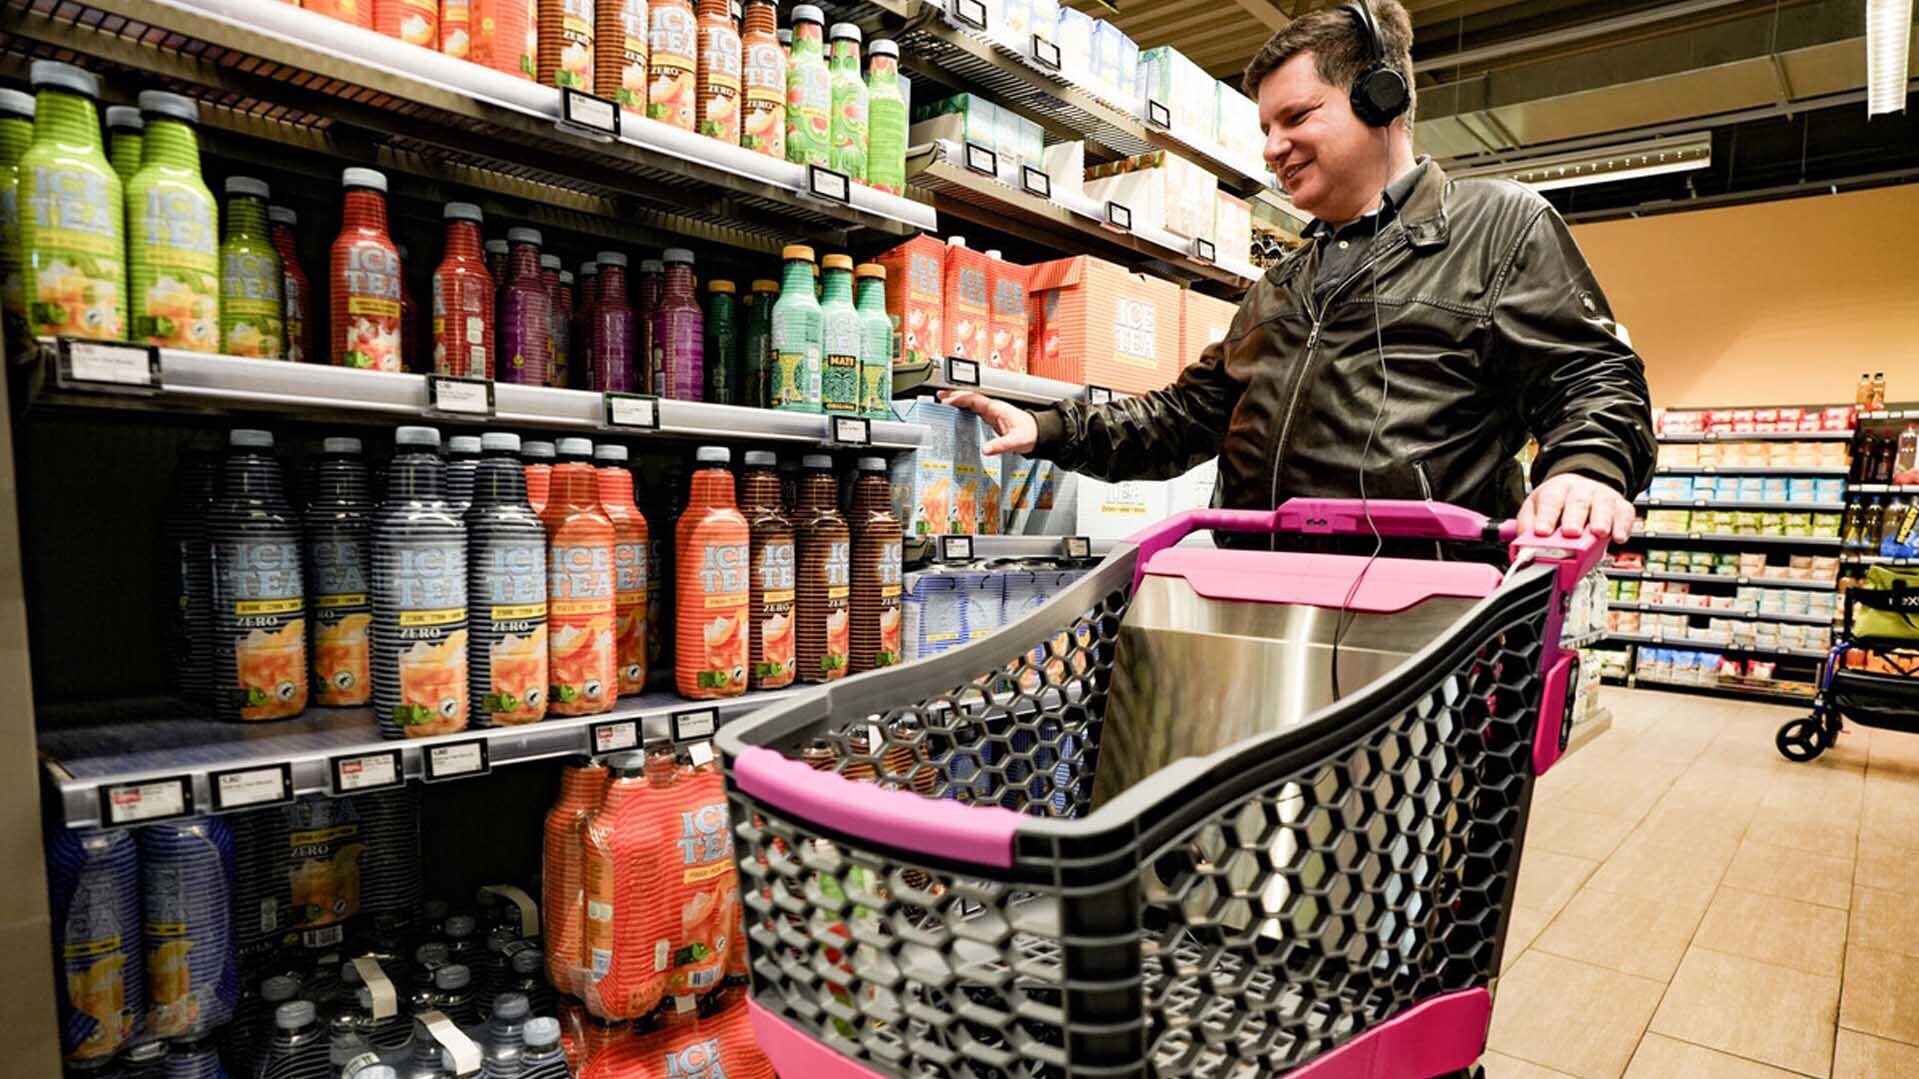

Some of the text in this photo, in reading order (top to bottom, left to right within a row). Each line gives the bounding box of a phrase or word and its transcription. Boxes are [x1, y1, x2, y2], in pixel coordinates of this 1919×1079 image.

[651, 66, 679, 77] ZERO
[708, 85, 736, 98] ZERO
[747, 100, 774, 110] ZERO
[35, 167, 108, 199] ICE
[29, 197, 115, 237] TEA
[226, 255, 274, 278] ICE
[349, 247, 399, 273] ICE
[223, 275, 280, 302] TEA
[344, 269, 400, 298] TEA
[1118, 298, 1156, 331] ICE
[1114, 325, 1157, 361] TEA
[237, 543, 298, 570] ICE
[400, 549, 466, 576] ICE
[552, 546, 610, 572] ICE
[615, 544, 647, 567] CE
[831, 542, 849, 562] IC
[883, 543, 902, 563] IC
[229, 569, 303, 596] TEA
[551, 572, 612, 598] TEA
[237, 616, 279, 627] ZERO
[763, 604, 790, 613] ZERO
[400, 628, 441, 640] ZERO
[492, 621, 529, 632] ZERO
[290, 845, 330, 857] ZERO
[665, 1037, 721, 1077] ICE
